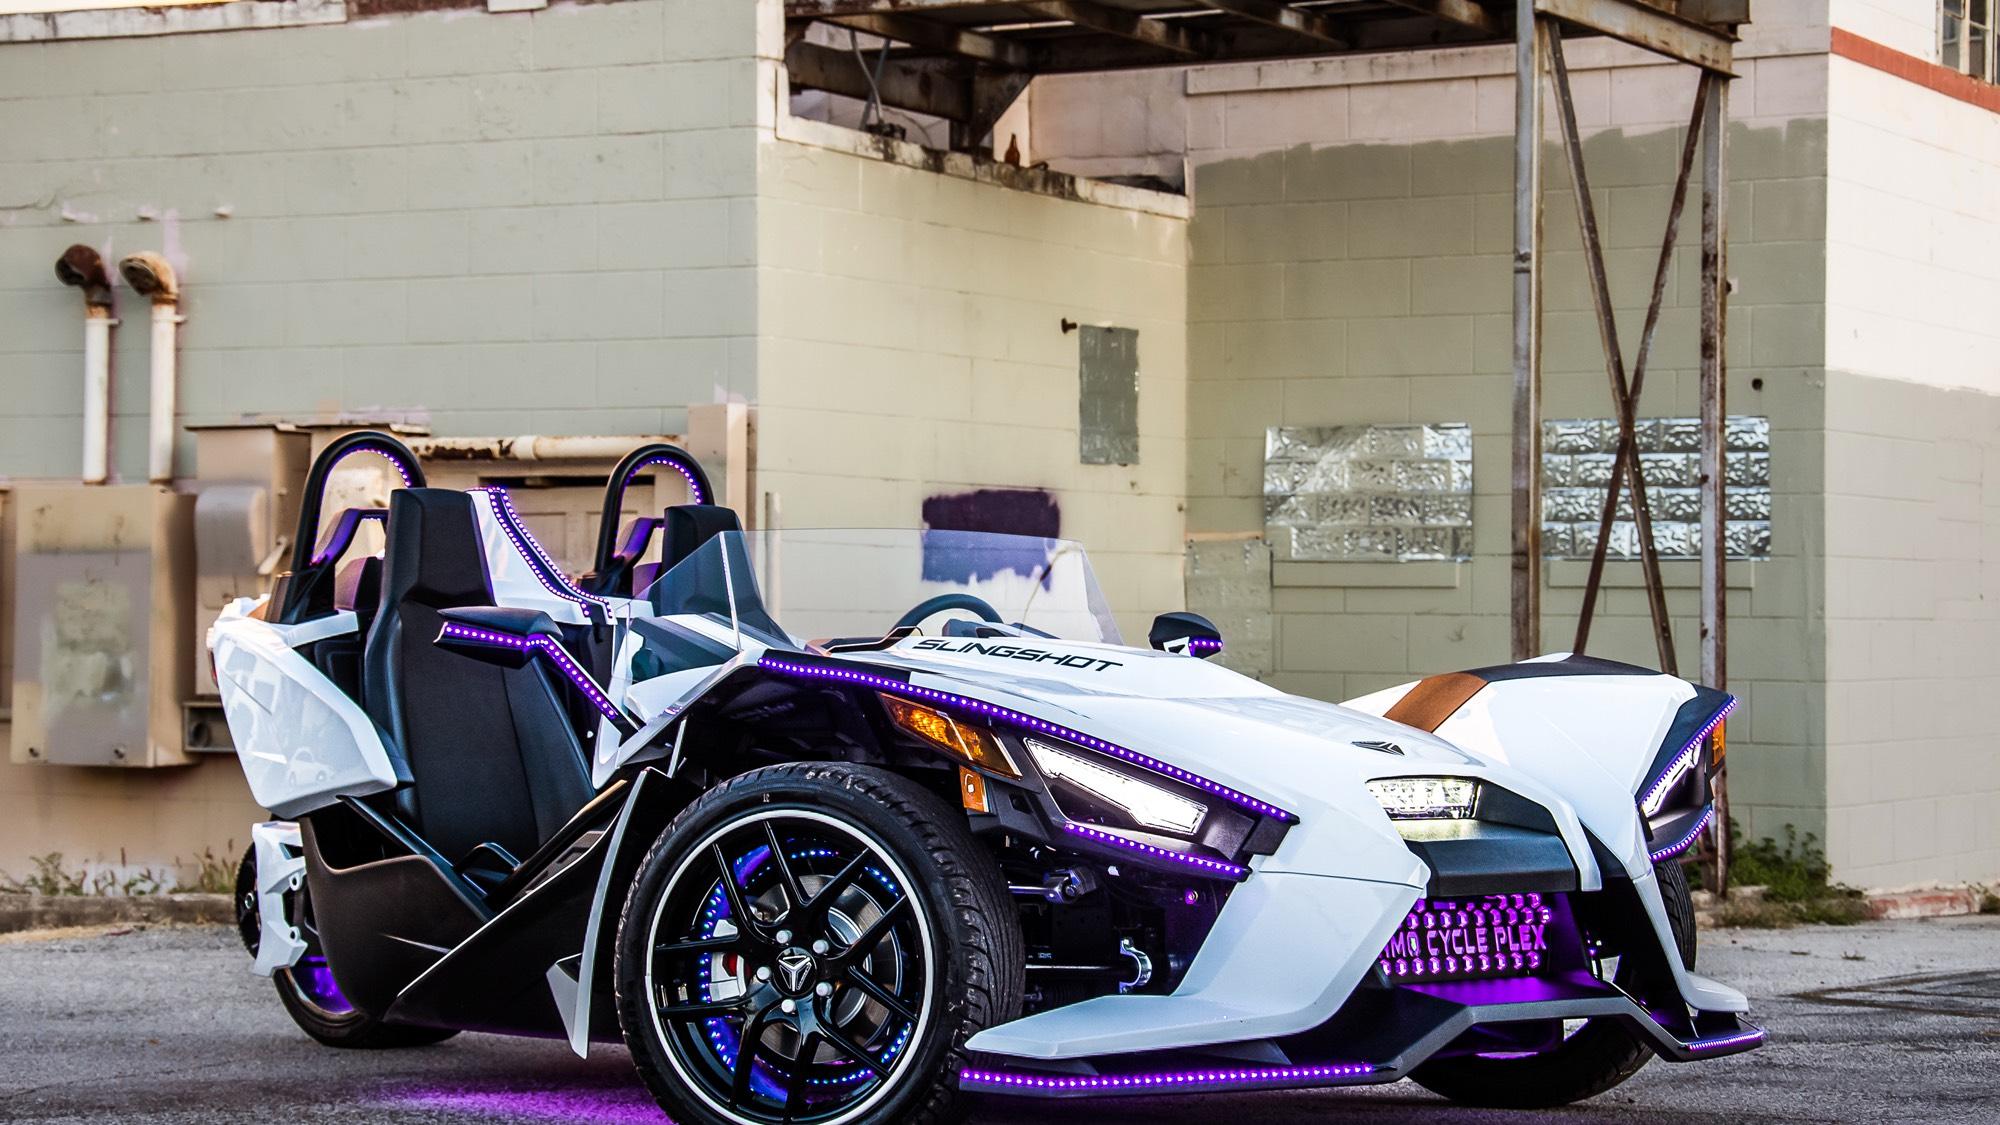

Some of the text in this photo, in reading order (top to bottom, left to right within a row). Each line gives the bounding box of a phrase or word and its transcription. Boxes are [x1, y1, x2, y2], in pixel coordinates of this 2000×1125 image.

[912, 639, 1124, 672] SLINGSHOT
[1426, 927, 1488, 956] CYCLE
[1494, 923, 1546, 951] PLEX
